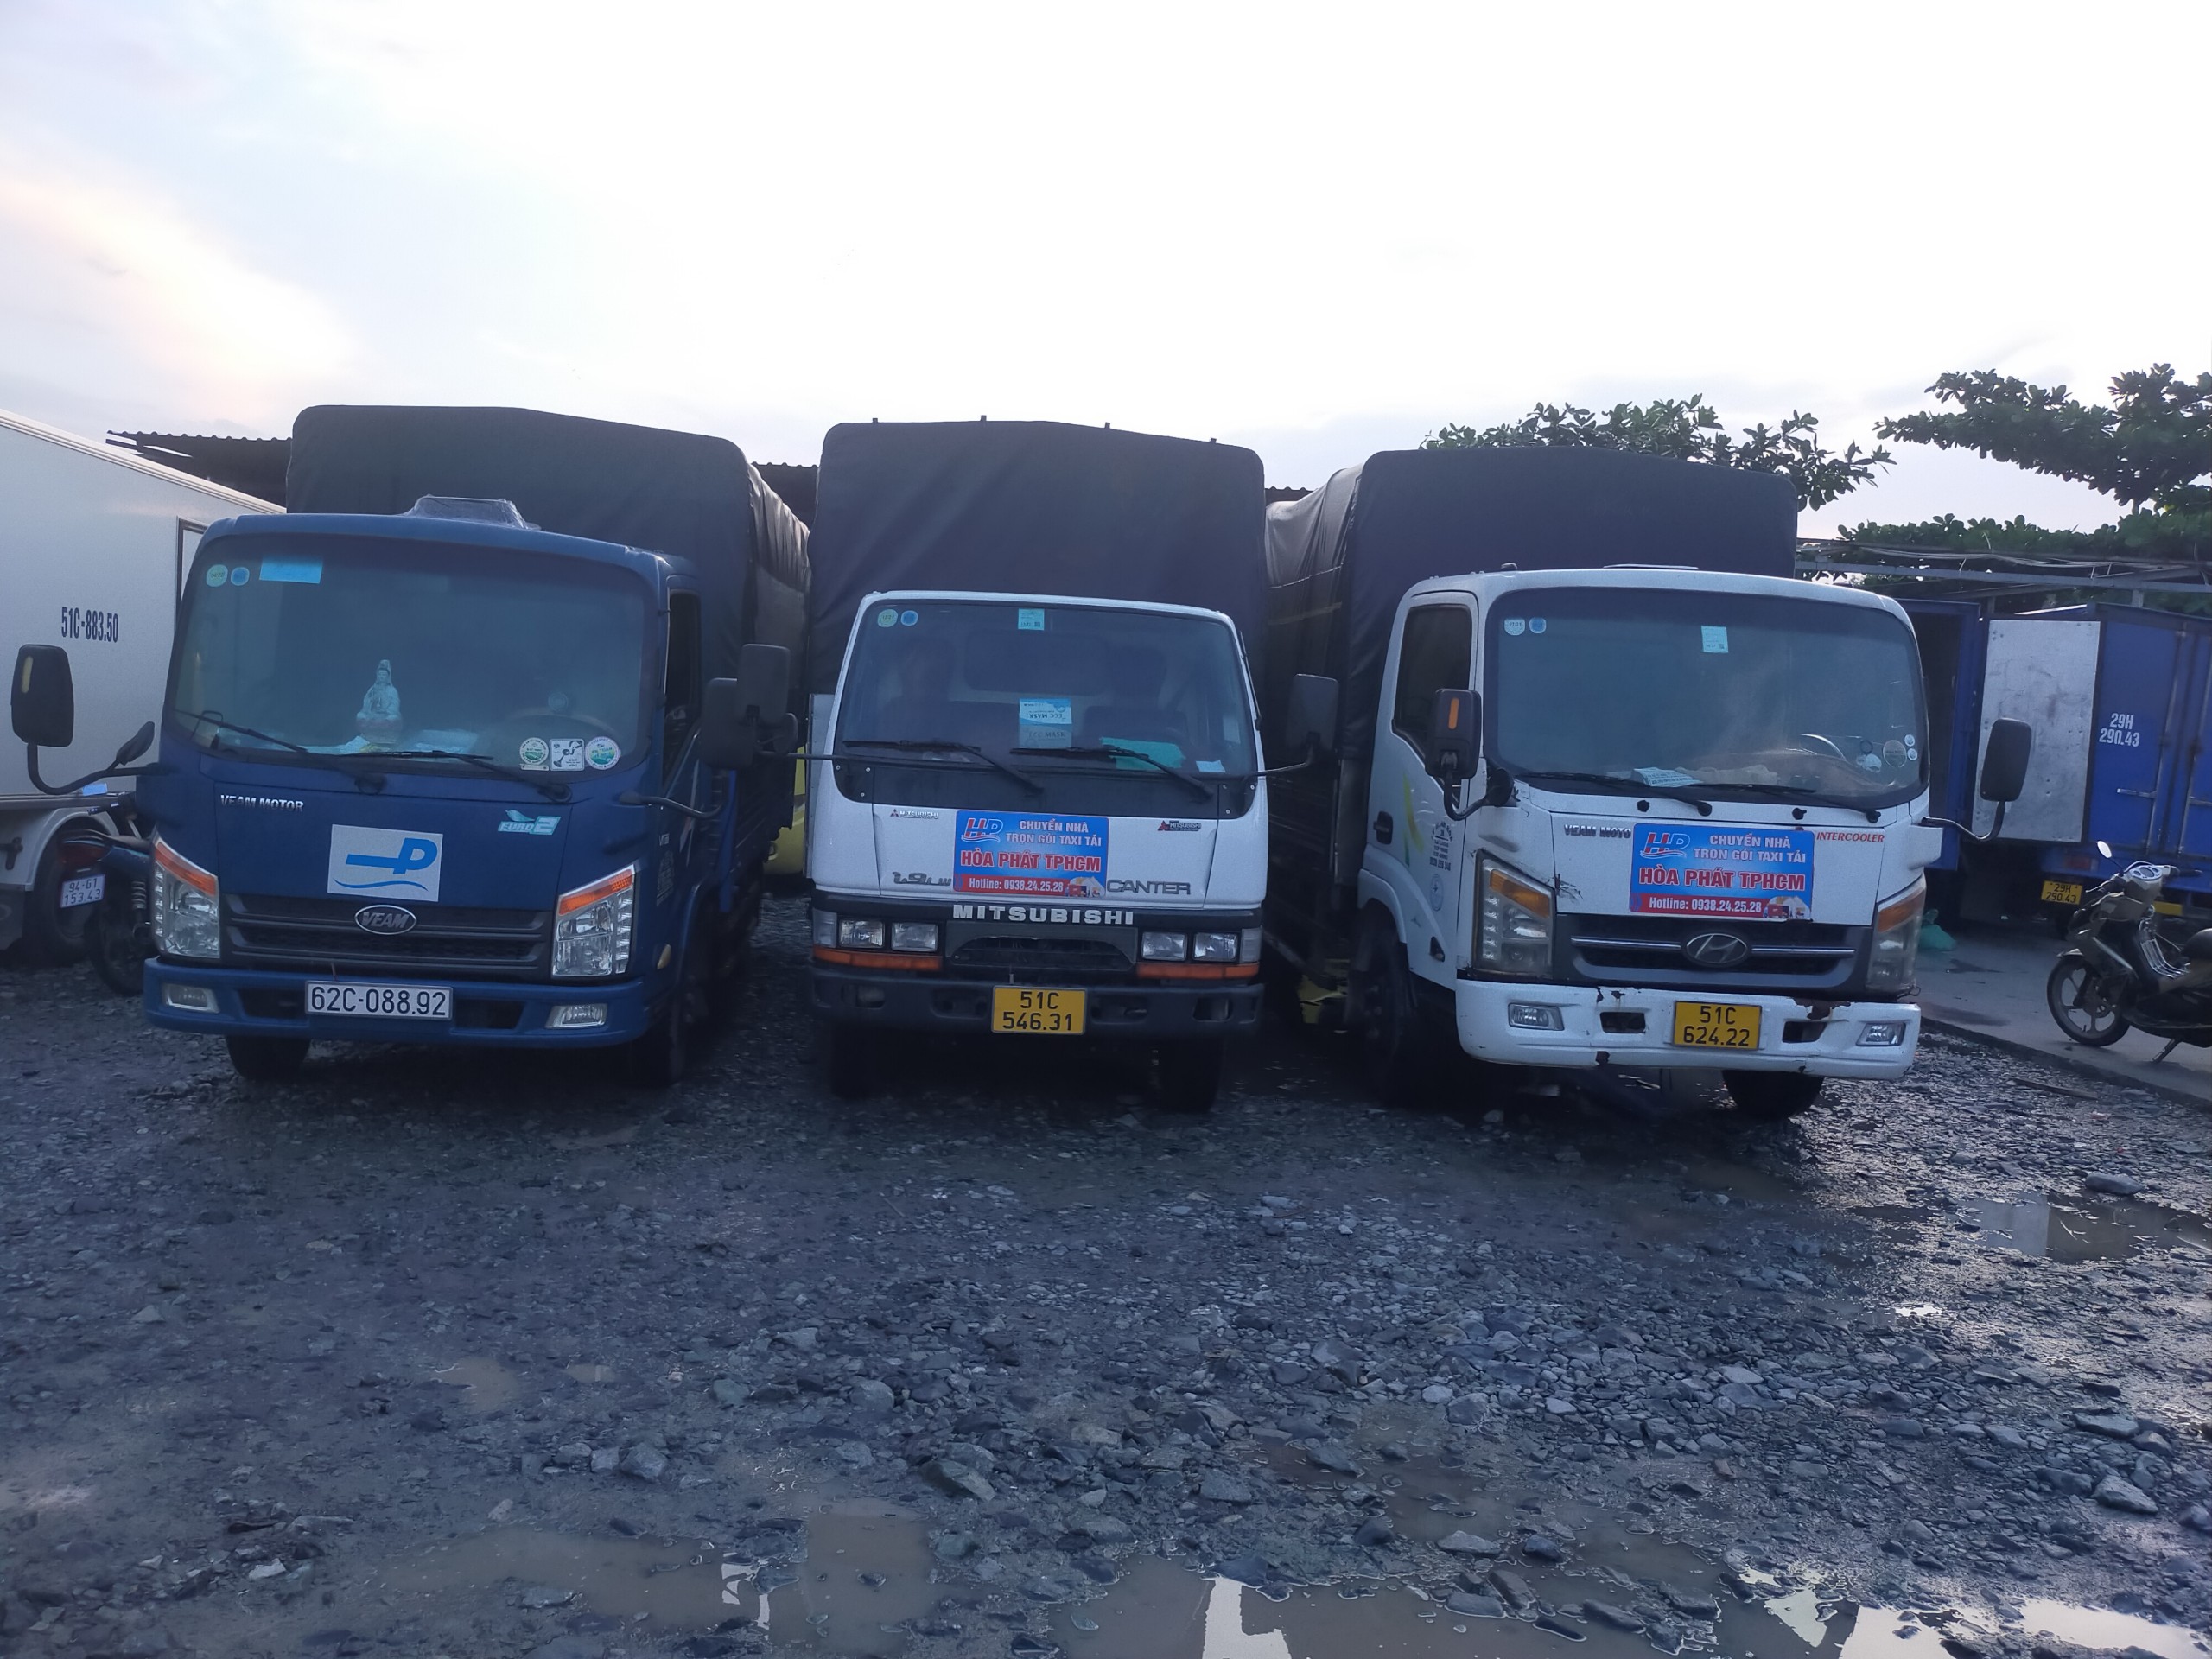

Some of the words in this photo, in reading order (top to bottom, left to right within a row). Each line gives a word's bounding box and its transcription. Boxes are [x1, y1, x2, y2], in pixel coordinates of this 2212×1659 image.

[60, 607, 119, 643] 51C-883.50
[2109, 712, 2134, 730] 29H
[2099, 728, 2140, 747] 290.43
[220, 794, 257, 809] VEAM
[259, 798, 304, 812] MOTOR
[1020, 818, 1063, 832] CHUYỂN
[1065, 822, 1089, 833] NHÀ
[1564, 824, 1597, 837] VEAM
[1599, 826, 1631, 838] MOTO
[1007, 833, 1034, 843] TRỌN
[1059, 835, 1082, 846] TAXI
[1084, 834, 1102, 847] TẢI
[1710, 833, 1761, 847] CHUYỂN
[1764, 836, 1791, 849] NHÀ
[1816, 832, 1885, 842] INTERCOOLER
[961, 848, 994, 867] HÒA
[998, 850, 1039, 869] PHÁT
[1045, 855, 1102, 873] TPHCM
[1694, 848, 1727, 861] TRỌN
[1732, 848, 1753, 861] GÓI
[1758, 851, 1783, 862] TAXI
[1786, 850, 1806, 863] TẢI
[69, 878, 97, 893] 94-G1
[969, 878, 1002, 890] Hotline:
[1004, 879, 1064, 892] 0938.24.25.28
[1639, 864, 1680, 886] HÒA
[1684, 867, 1735, 888] PHÁT
[1739, 872, 1806, 892] TPHCM
[1107, 879, 1191, 895] CANTER
[2054, 883, 2072, 893] 29H
[1649, 896, 1689, 910] Hotline:
[1691, 899, 1762, 913] 0938.24.25.28
[2045, 892, 2077, 904] 290.43
[362, 912, 410, 929] VEAM
[952, 904, 1134, 925] MITSUBISHI
[311, 986, 446, 1016] 62C-088.92
[1020, 991, 1059, 1009] 51C
[1002, 1011, 1072, 1031] 546.31
[1700, 1005, 1736, 1025] 51C
[1683, 1026, 1750, 1046] 624.22
